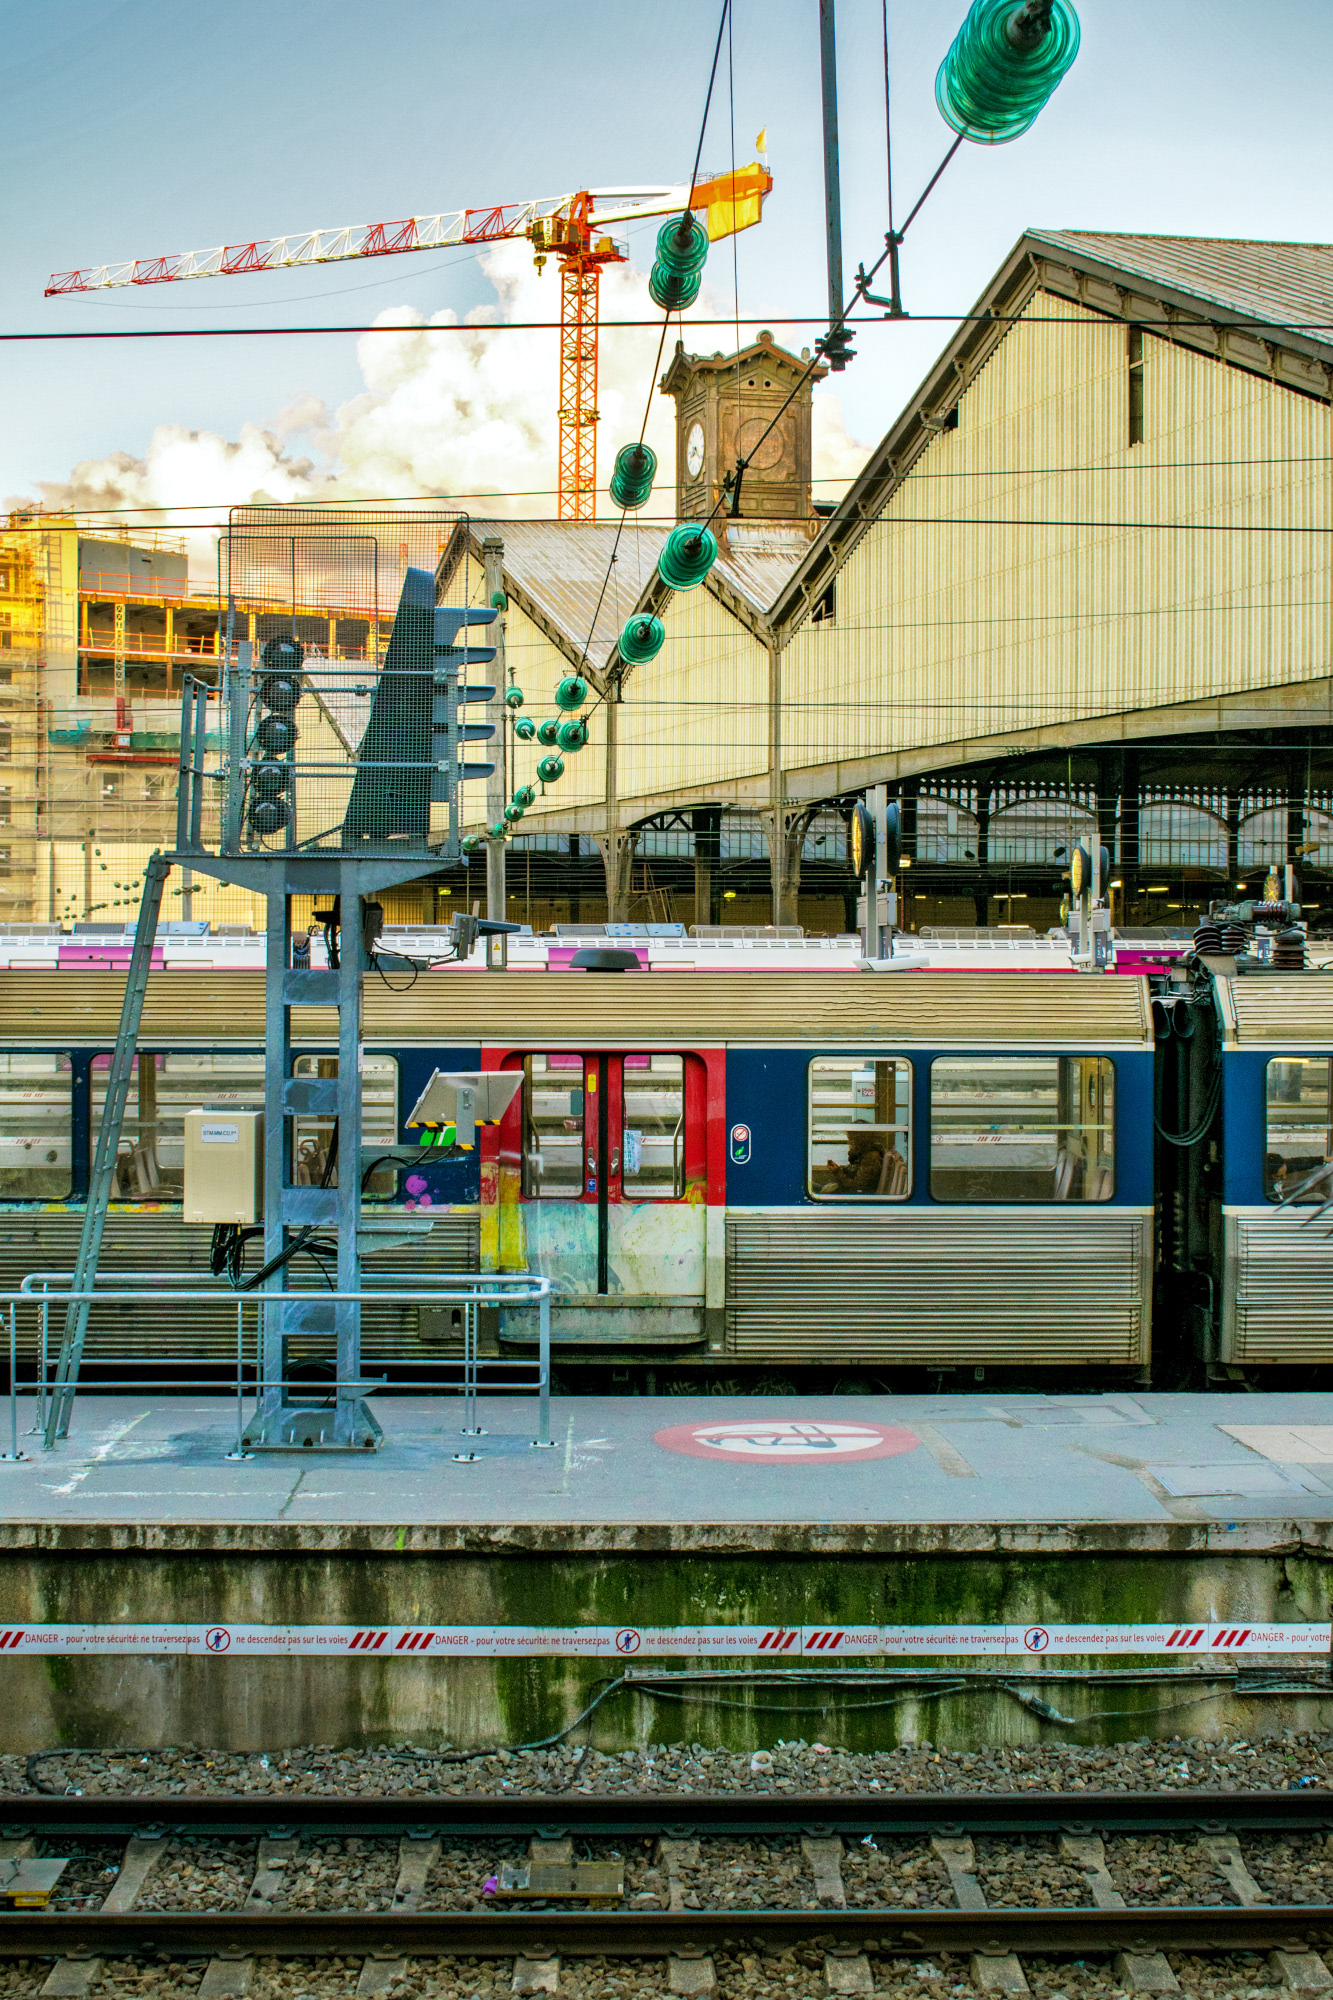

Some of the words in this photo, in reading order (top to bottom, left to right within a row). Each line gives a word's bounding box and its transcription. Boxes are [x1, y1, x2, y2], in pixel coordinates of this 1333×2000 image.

[25, 1634, 59, 1643] DANGER
[66, 1636, 83, 1645] pour
[85, 1635, 105, 1643] votre
[107, 1634, 139, 1643] sécurité:
[152, 1635, 187, 1643] traversez
[187, 1636, 200, 1645] pas
[247, 1635, 286, 1644] descendez
[288, 1637, 301, 1646] pas
[316, 1635, 327, 1644] les
[329, 1635, 348, 1644] voies
[435, 1635, 469, 1645] DANGER
[476, 1638, 494, 1647] pour
[495, 1636, 515, 1645] votre
[517, 1636, 549, 1645] sécurité:
[562, 1636, 597, 1645] traversez
[597, 1638, 610, 1647] pas
[657, 1635, 696, 1644] descendez
[698, 1637, 711, 1646] pas
[726, 1635, 737, 1644] les
[738, 1636, 758, 1644] voies
[845, 1634, 878, 1644] DANGER
[885, 1637, 903, 1646] pour
[904, 1635, 924, 1644] votre
[926, 1634, 958, 1644] sécurité:
[970, 1635, 1005, 1643] traversez
[1006, 1636, 1019, 1645] pas
[1065, 1634, 1104, 1643] descendez
[1105, 1635, 1119, 1644] pas
[1133, 1633, 1145, 1642] les
[1146, 1633, 1165, 1642] voies
[1251, 1632, 1284, 1642] DANGER
[1292, 1635, 1308, 1644] pour
[1310, 1634, 1330, 1642] votre
